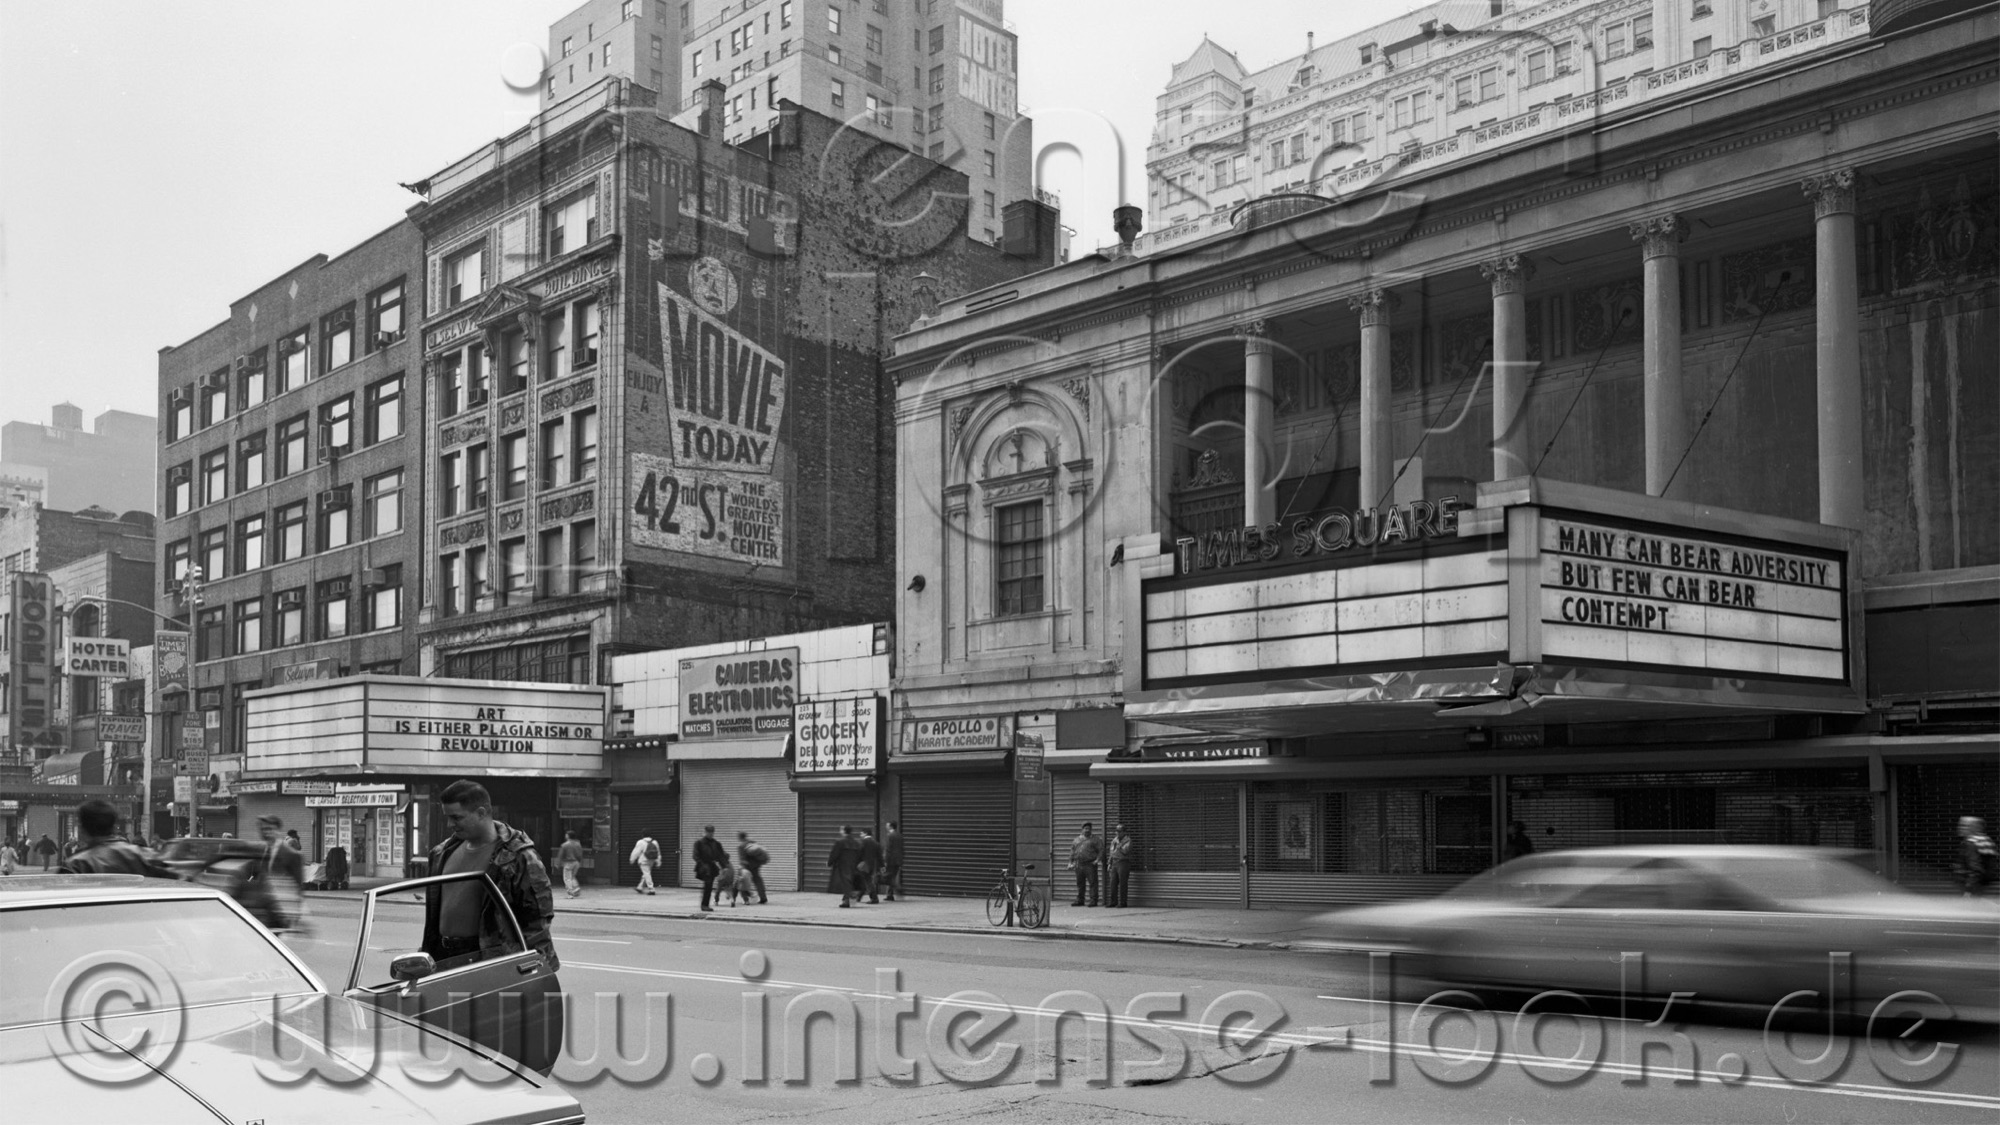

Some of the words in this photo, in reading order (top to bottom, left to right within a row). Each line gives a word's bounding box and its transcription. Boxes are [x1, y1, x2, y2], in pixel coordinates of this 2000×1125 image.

[959, 15, 1016, 79] HOTEL
[958, 57, 1016, 120] CARTER
[545, 262, 601, 297] BUILDING
[667, 297, 783, 435] MOVIE
[627, 370, 663, 394] ENJOY
[640, 395, 649, 414] A
[677, 420, 769, 465] TODAY
[741, 482, 765, 496] THE
[634, 471, 698, 535] 42nd
[700, 483, 729, 542] ST.
[731, 492, 779, 513] WORLD'S
[727, 506, 781, 526] GREATEST
[732, 521, 775, 542] MOVIE
[1176, 521, 1281, 574] TIMES
[1292, 496, 1459, 556] SQUARE
[731, 537, 778, 560] CENTER
[1559, 525, 1616, 557] MANY
[1626, 536, 1662, 565] CAN
[1670, 543, 1721, 571] BEAR
[1731, 551, 1827, 586] ADVERSITY
[1562, 561, 1602, 589] BUT
[1612, 568, 1652, 596] FEW
[1662, 575, 1700, 602] CAN
[1708, 580, 1756, 608] BEAR
[1561, 596, 1669, 631] CONTEMPT
[21, 581, 47, 728] MODELLS
[72, 642, 127, 657] HOTEL
[70, 658, 128, 673] CARTER
[715, 657, 793, 686] CAMERAS
[688, 685, 794, 715] ELECTRONICS
[477, 707, 506, 720] ART
[716, 717, 753, 726] CALCULATORS
[851, 708, 872, 717] SODAS
[101, 723, 144, 734] TRAVEL
[395, 720, 411, 733] IS
[418, 721, 472, 735] EITHER
[479, 723, 569, 738] PLAGIARISM
[574, 727, 593, 739] OR
[685, 723, 711, 733] WATCHES
[757, 718, 790, 729] LUGGAGE
[800, 721, 869, 741] GROCERY
[932, 720, 982, 735] APOLLO
[441, 738, 534, 752] REVOLUTION
[800, 745, 818, 757] DELI
[824, 744, 852, 756] CANDY
[918, 736, 951, 748] KARATE
[954, 734, 996, 747] ACADEMY
[799, 760, 808, 768] ICE
[378, 794, 394, 804] TOWN
